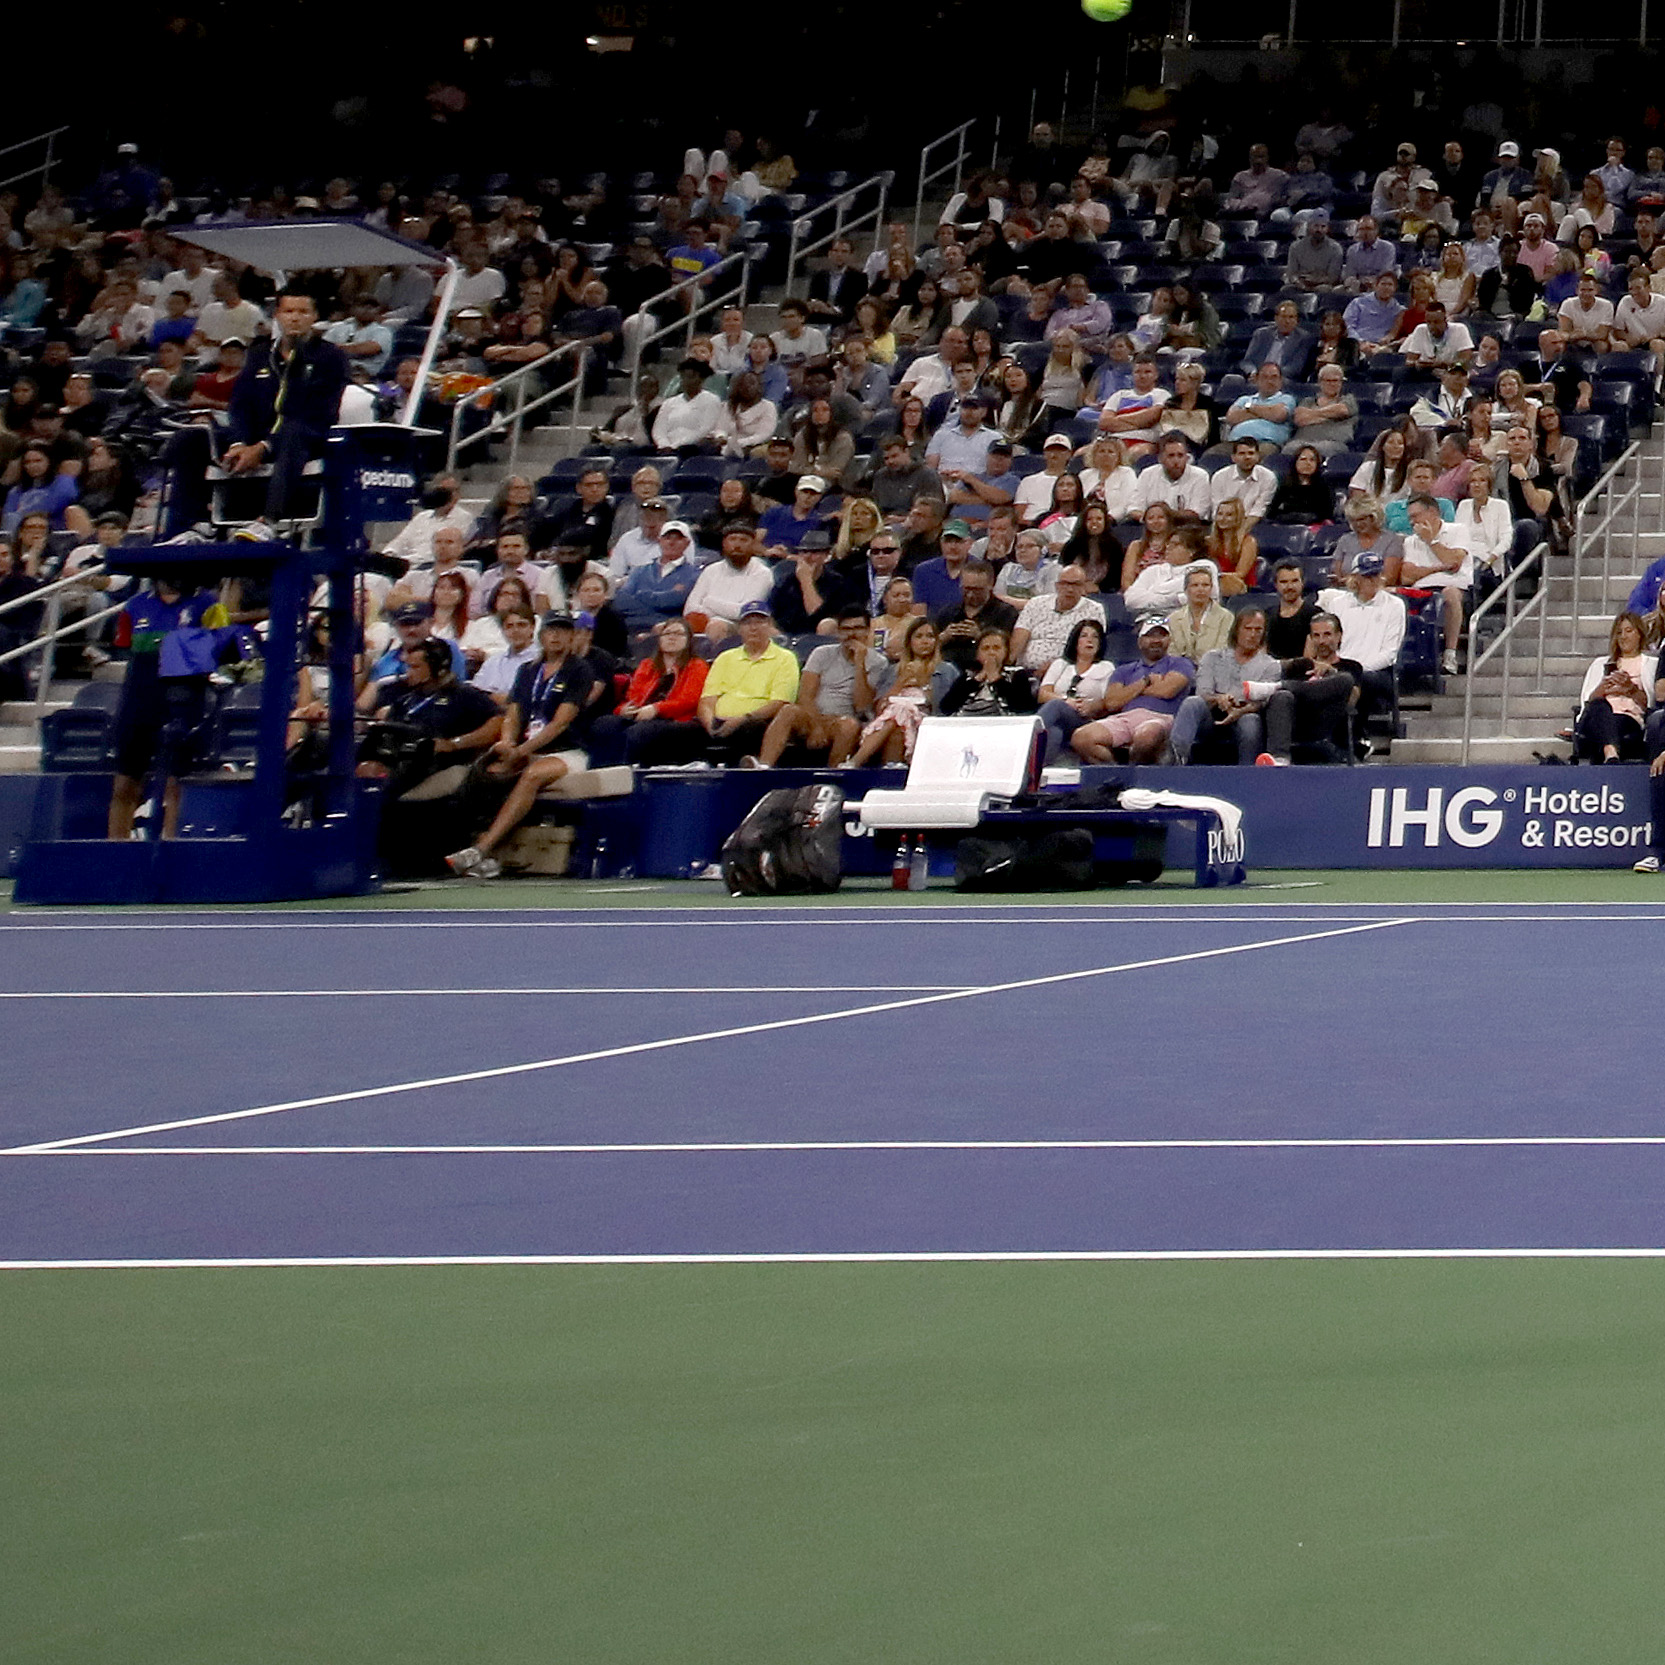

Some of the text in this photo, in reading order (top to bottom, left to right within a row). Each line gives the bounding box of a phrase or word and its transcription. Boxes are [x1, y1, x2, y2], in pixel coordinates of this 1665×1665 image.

[1524, 785, 1625, 814] Hotels
[1521, 820, 1652, 847] & Resort
